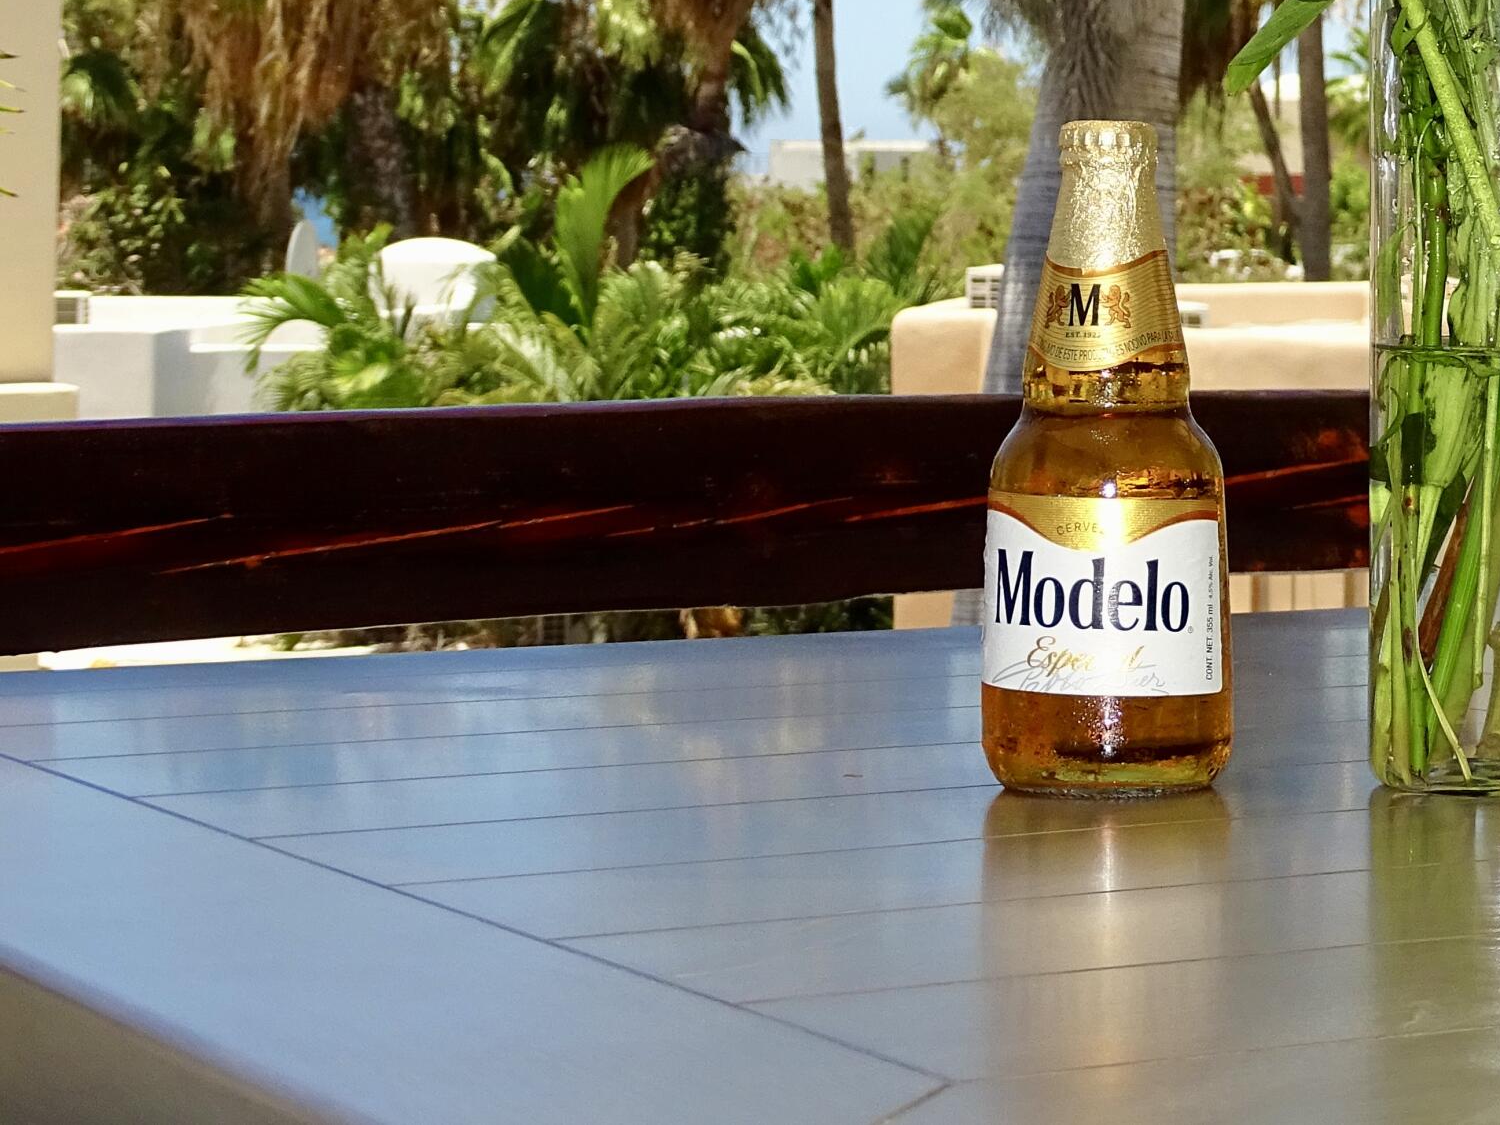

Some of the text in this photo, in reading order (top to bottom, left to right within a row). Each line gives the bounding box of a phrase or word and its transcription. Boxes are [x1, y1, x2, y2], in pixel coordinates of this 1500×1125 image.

[1068, 283, 1102, 327] M
[1063, 348, 1078, 361] ESTE
[995, 548, 1190, 633] Modelo
[1206, 616, 1214, 633] 355
[1207, 604, 1214, 615] ml
[1026, 635, 1145, 678] Especl
